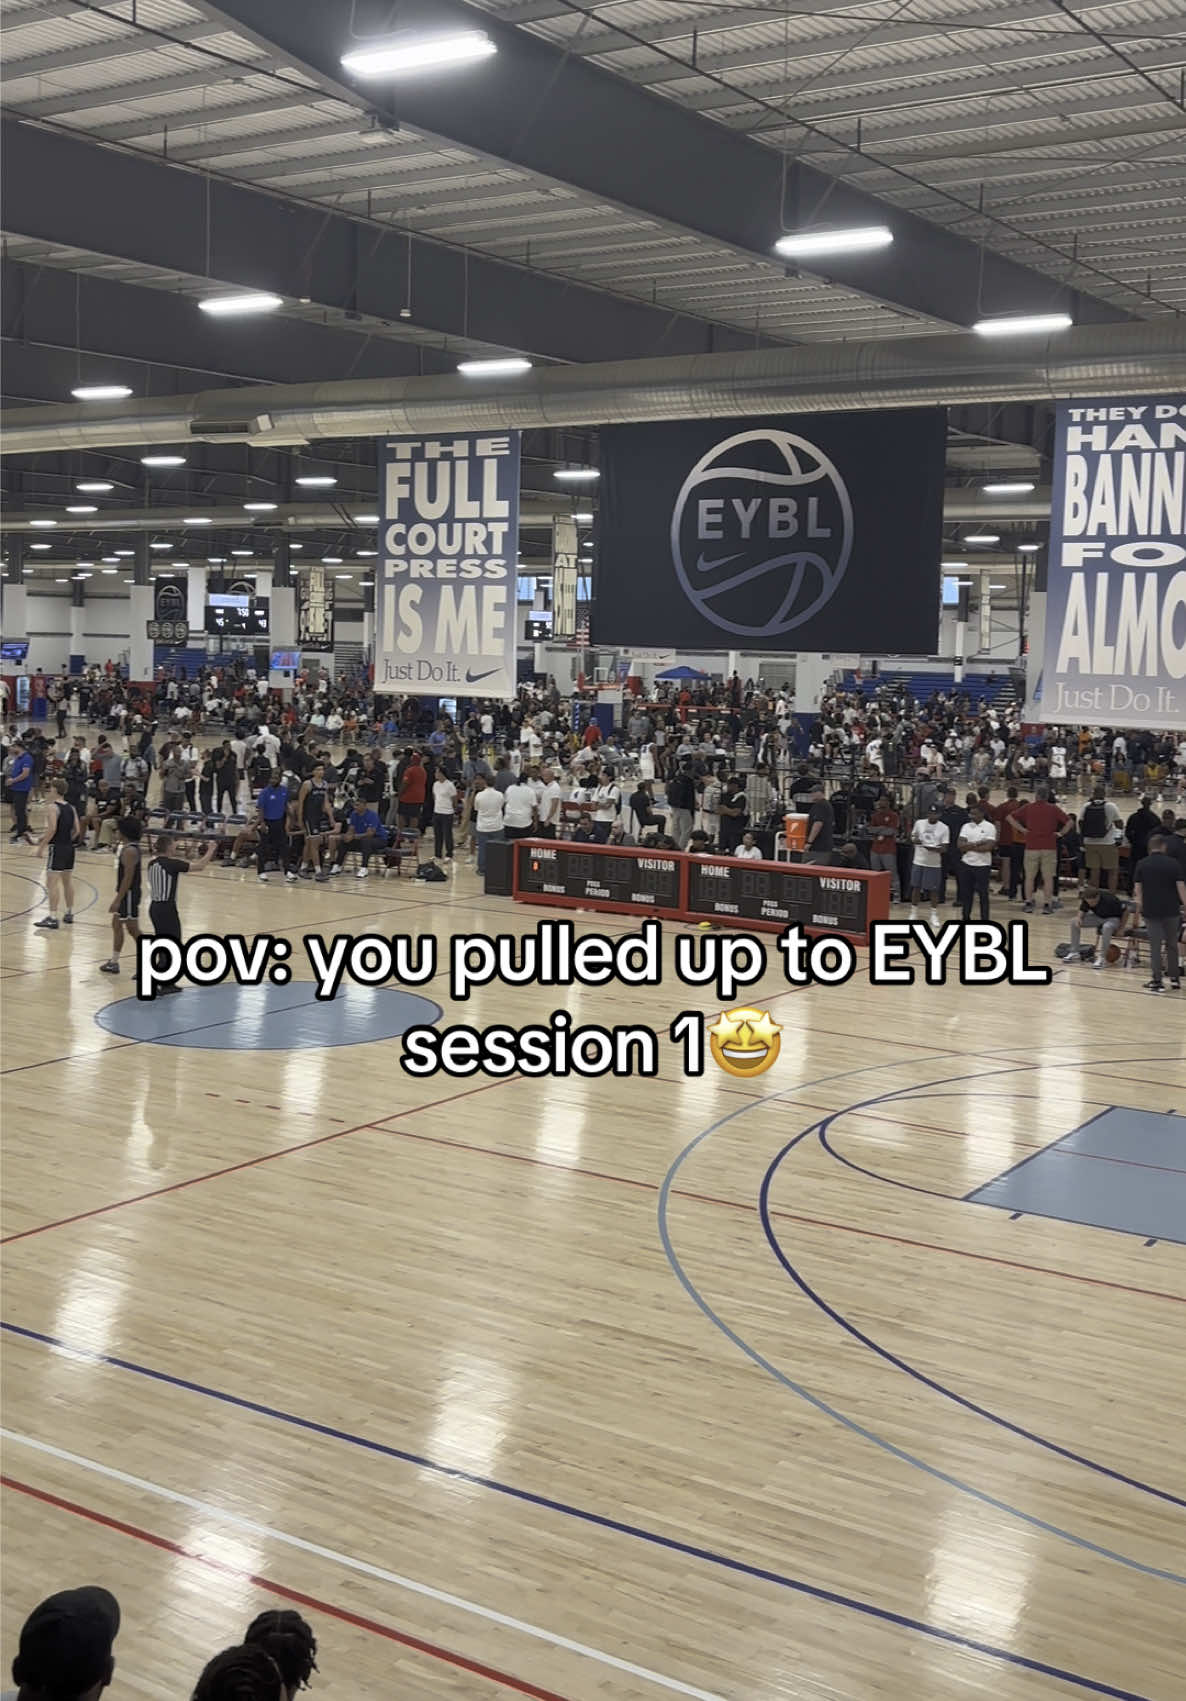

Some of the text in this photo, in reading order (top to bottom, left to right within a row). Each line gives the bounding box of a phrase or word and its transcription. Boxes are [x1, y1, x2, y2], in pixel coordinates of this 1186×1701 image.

[1068, 406, 1148, 422] THEY
[386, 437, 510, 459] THE
[1066, 422, 1186, 452] HAN
[385, 458, 510, 520] FULL
[1063, 451, 1186, 536] BANN
[698, 496, 832, 540] EYBL
[385, 522, 509, 556] COURT
[1061, 541, 1186, 567] FO
[384, 558, 508, 579] PRESS
[383, 583, 423, 654] IS
[434, 585, 507, 656] ME
[382, 659, 461, 684] Just Do It.
[1053, 682, 1180, 713] Just Do It.
[530, 847, 557, 860] HOME
[637, 857, 675, 872] VISITOR
[700, 864, 731, 878] HOME
[819, 877, 861, 892] VISITOR
